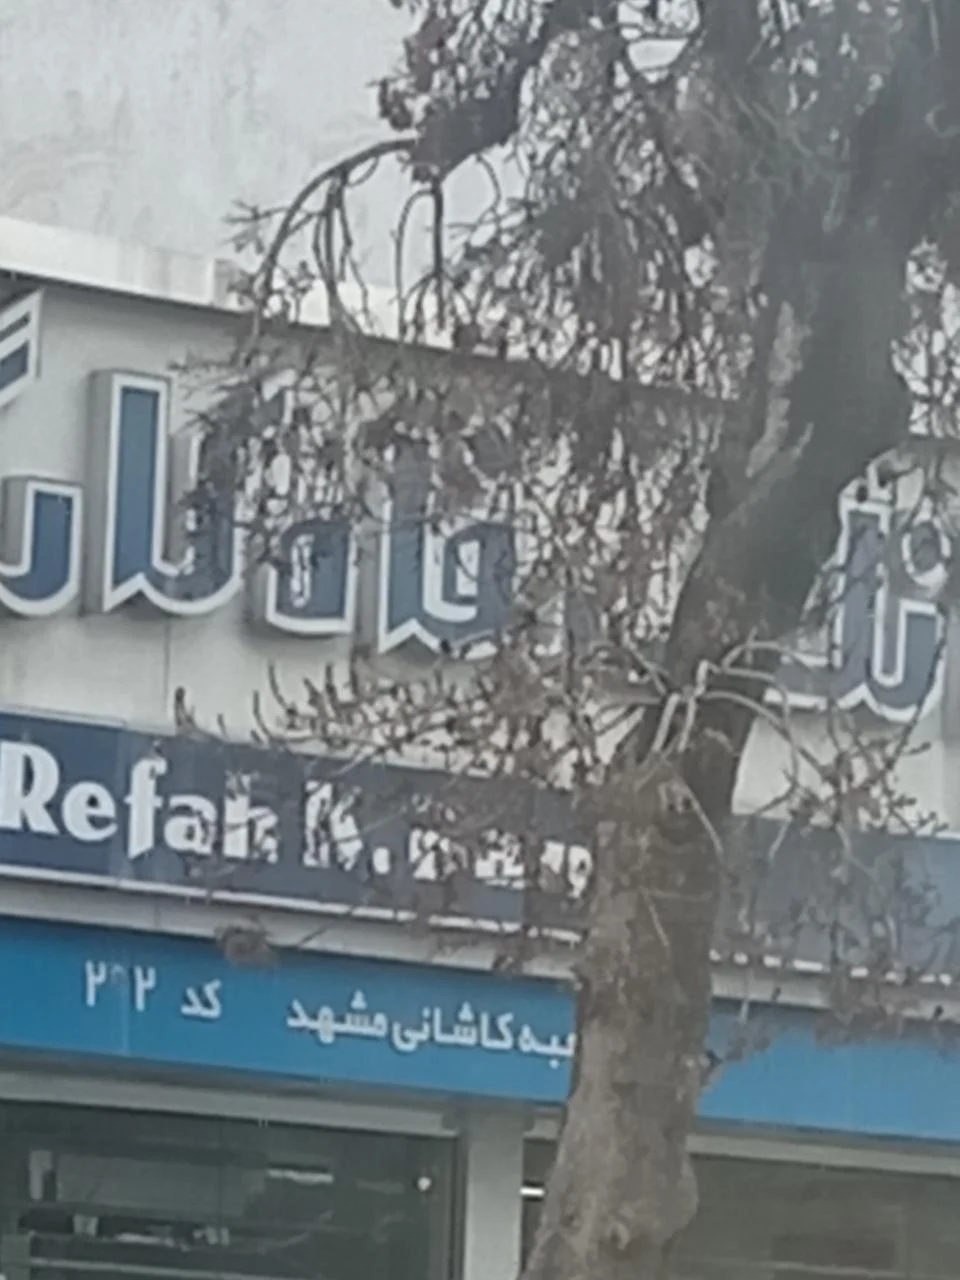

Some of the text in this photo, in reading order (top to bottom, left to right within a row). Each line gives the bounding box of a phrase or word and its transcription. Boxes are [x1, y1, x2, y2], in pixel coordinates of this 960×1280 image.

[180, 979, 222, 1020] کد
[286, 990, 388, 1043] مشهد
[392, 1001, 515, 1051] کاشانی
